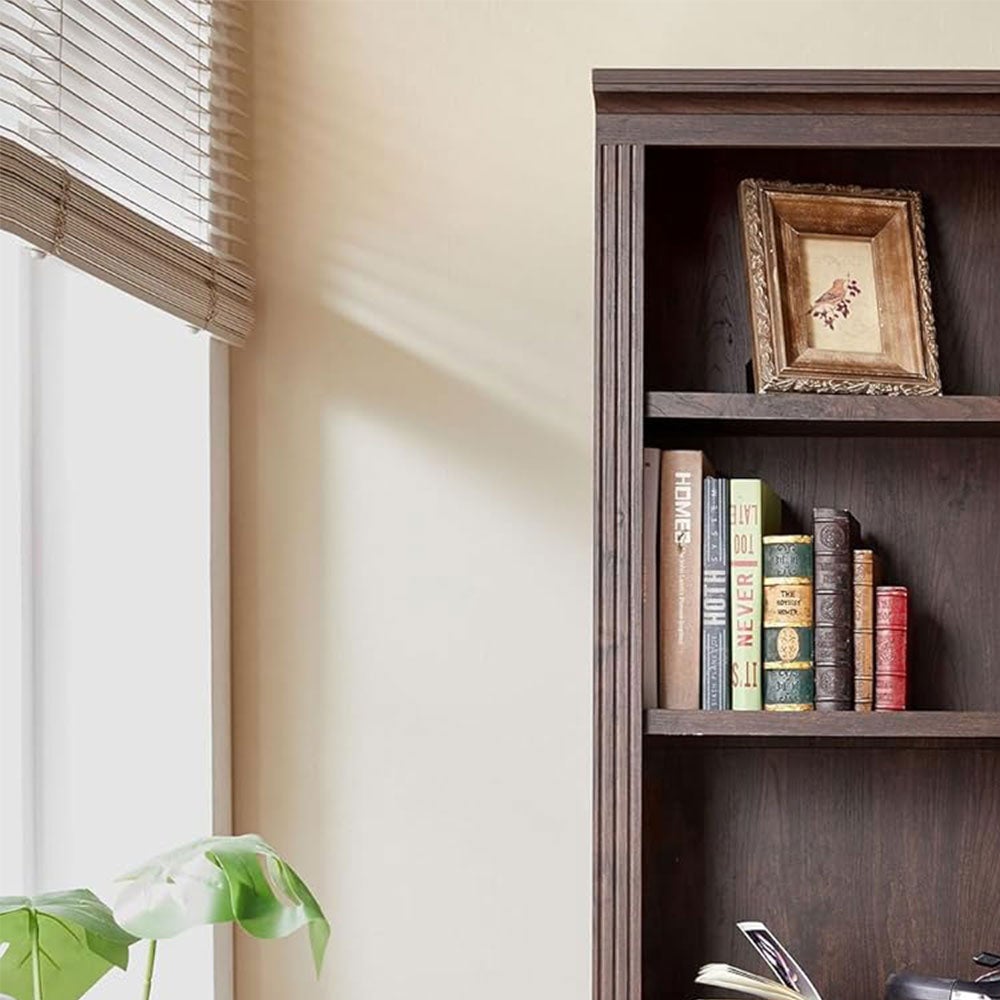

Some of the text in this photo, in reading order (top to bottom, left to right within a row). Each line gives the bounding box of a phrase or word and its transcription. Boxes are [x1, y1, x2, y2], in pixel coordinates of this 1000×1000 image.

[674, 471, 692, 544] HOMES
[730, 504, 758, 526] LATE
[734, 533, 753, 555] TOO
[704, 569, 726, 626] HOTH
[736, 573, 754, 647] NEVER
